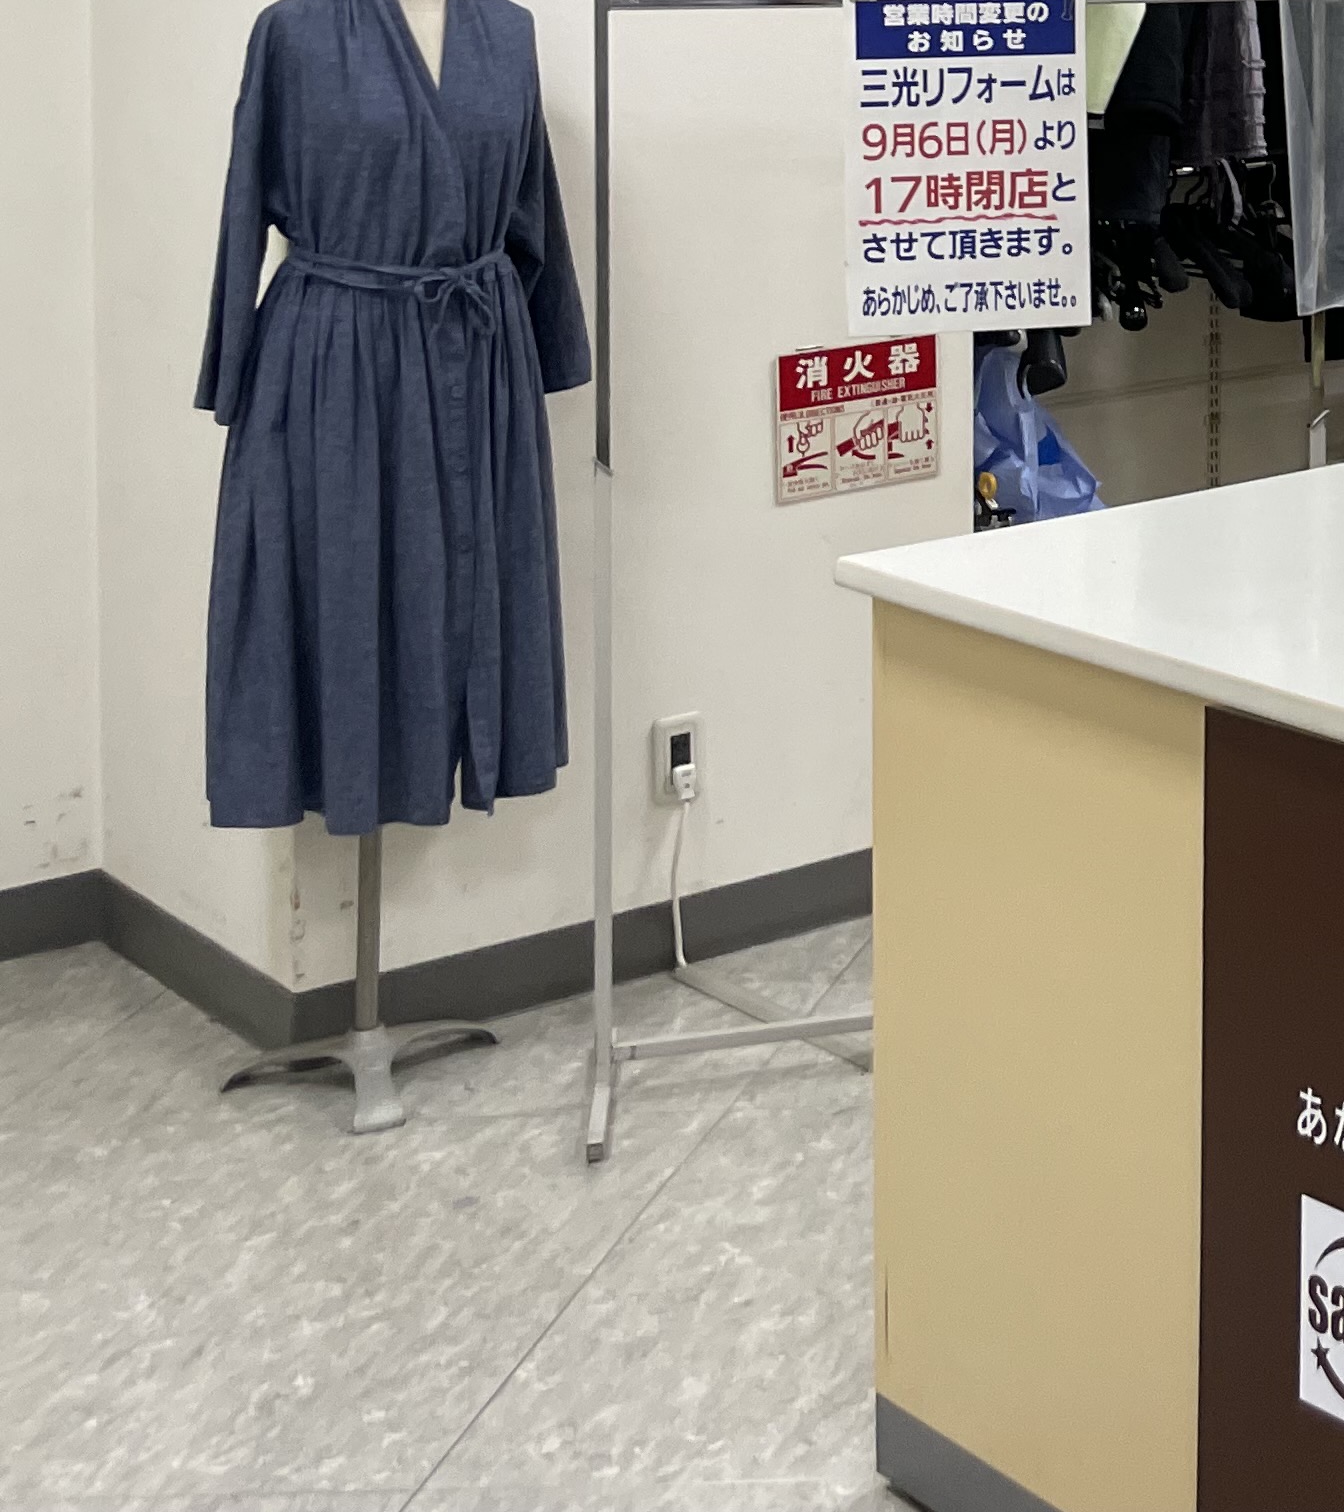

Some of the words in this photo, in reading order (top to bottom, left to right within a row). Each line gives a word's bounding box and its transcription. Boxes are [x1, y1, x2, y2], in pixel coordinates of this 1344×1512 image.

[883, 1, 1050, 27] 営業時間変更の
[907, 28, 1028, 53] お知らせ
[860, 64, 1077, 108] 三光リフォームは
[864, 168, 1077, 214] 17時閉店と
[862, 226, 1074, 264] させて頂きます。
[795, 341, 921, 390] 消火器
[811, 387, 834, 403] FIRE
[837, 377, 907, 398] EXTINGUISHER
